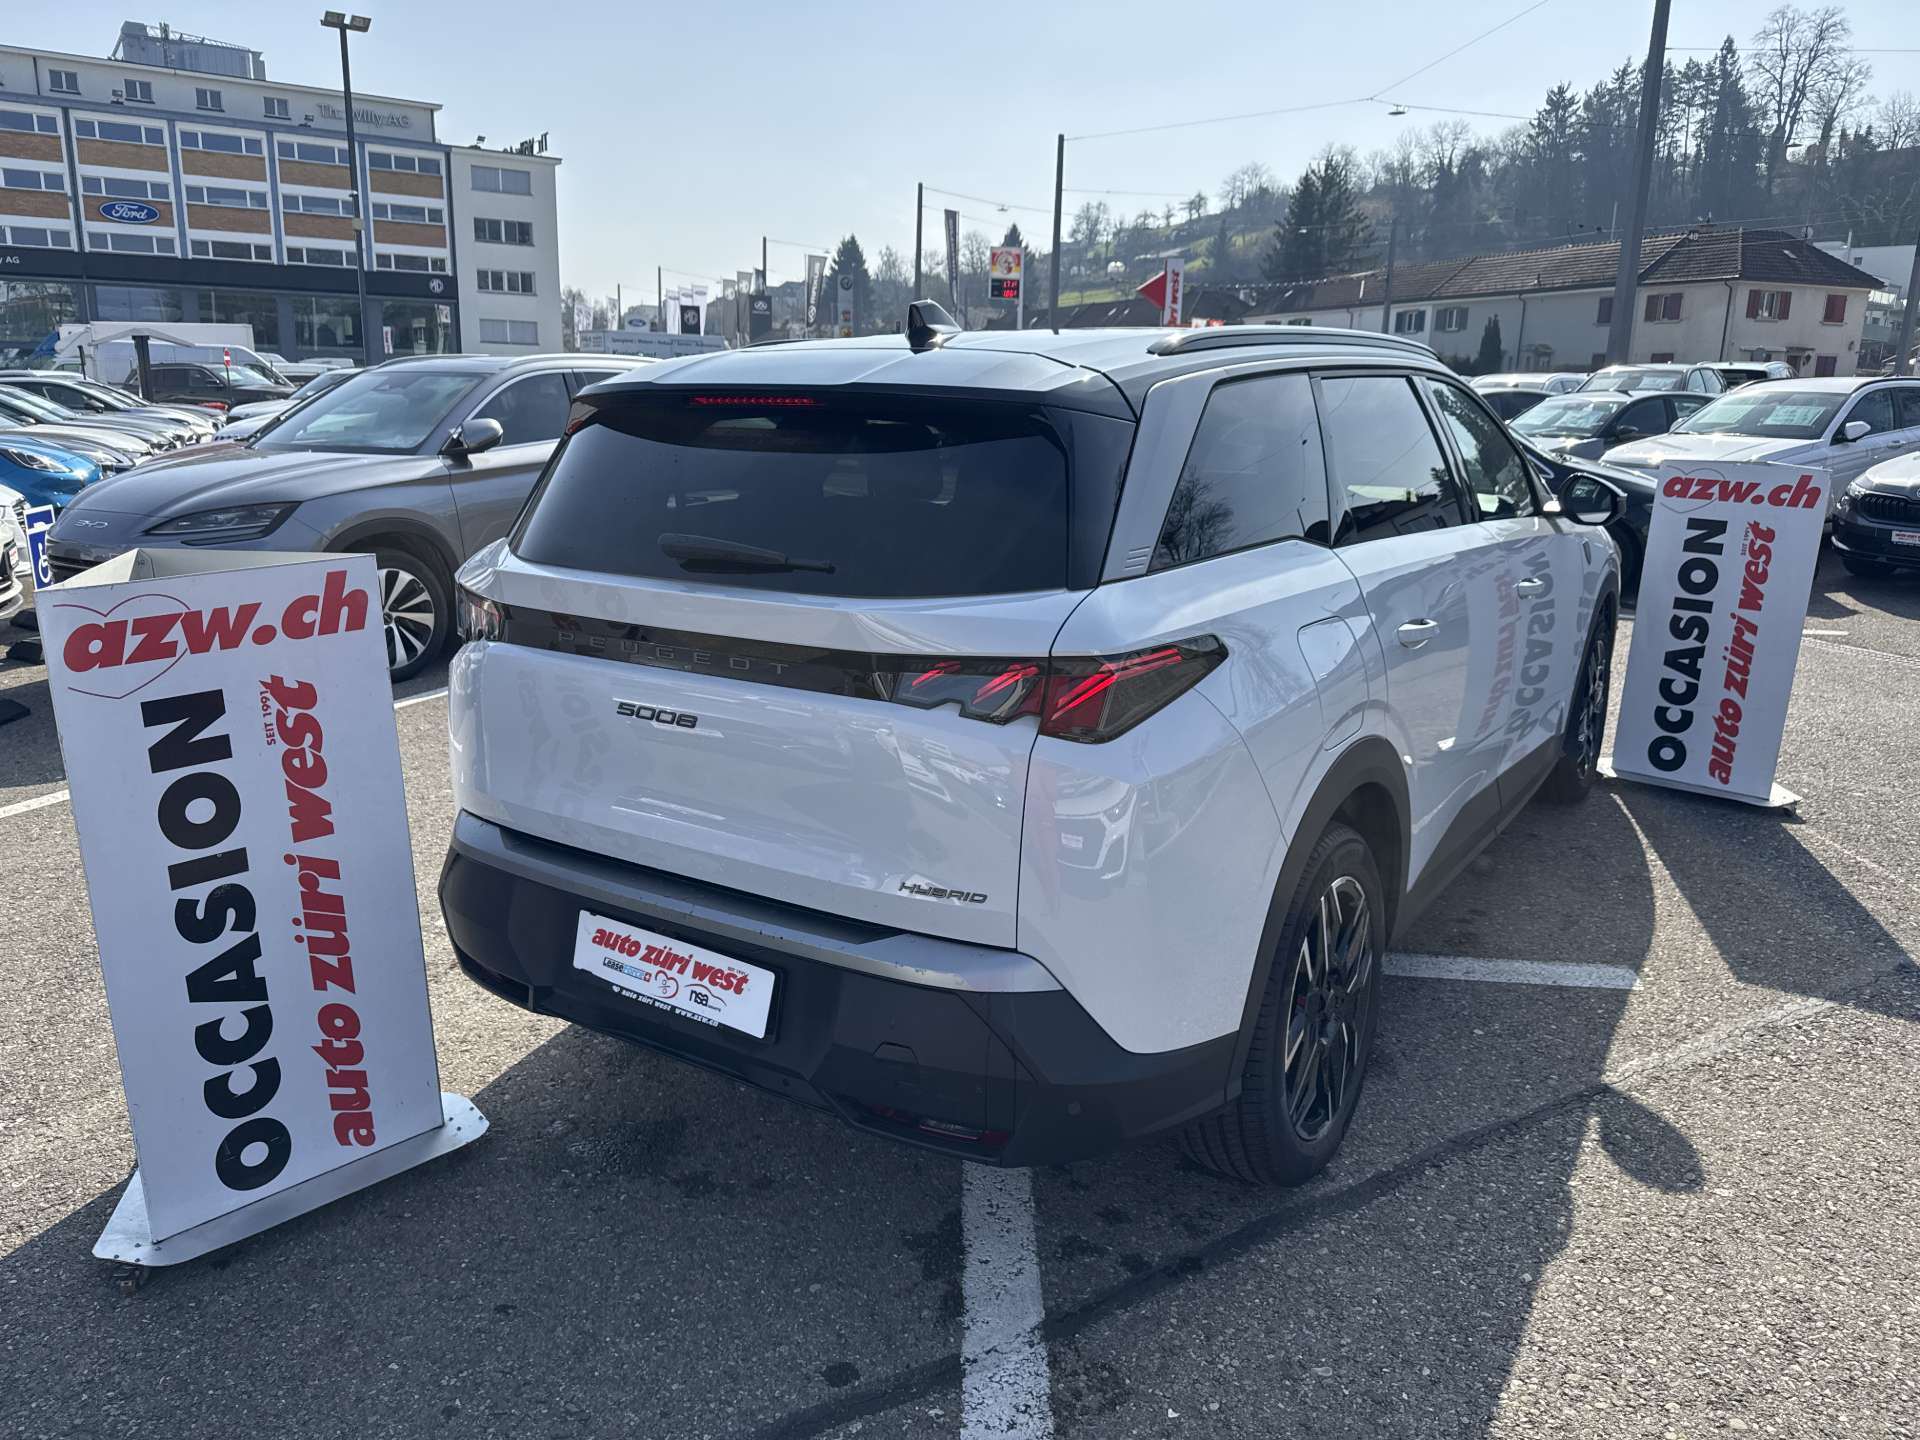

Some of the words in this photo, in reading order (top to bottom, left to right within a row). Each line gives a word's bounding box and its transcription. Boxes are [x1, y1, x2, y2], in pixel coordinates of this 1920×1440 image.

[385, 113, 410, 128] AG
[111, 203, 148, 220] Ford
[5, 255, 20, 264] AG
[683, 309, 699, 325] MG
[1663, 475, 1821, 509] azw.ch
[1738, 520, 1776, 612] west
[63, 570, 368, 672] azw.ch
[558, 631, 789, 675] PEUGEOT
[1648, 518, 1728, 772] OCCASION
[1723, 612, 1758, 700] züri
[260, 690, 272, 718] 1991
[616, 702, 698, 729] 5008
[264, 722, 276, 746] SEIT
[1709, 698, 1743, 785] auto
[259, 675, 336, 843] west
[898, 881, 988, 904] HYBRID
[141, 689, 292, 1191] OCCASION
[283, 853, 357, 995] züri
[592, 928, 641, 957] auto
[639, 945, 693, 975] züri
[692, 960, 749, 995] west
[689, 989, 709, 1007] nsa
[311, 1002, 376, 1148] auto
